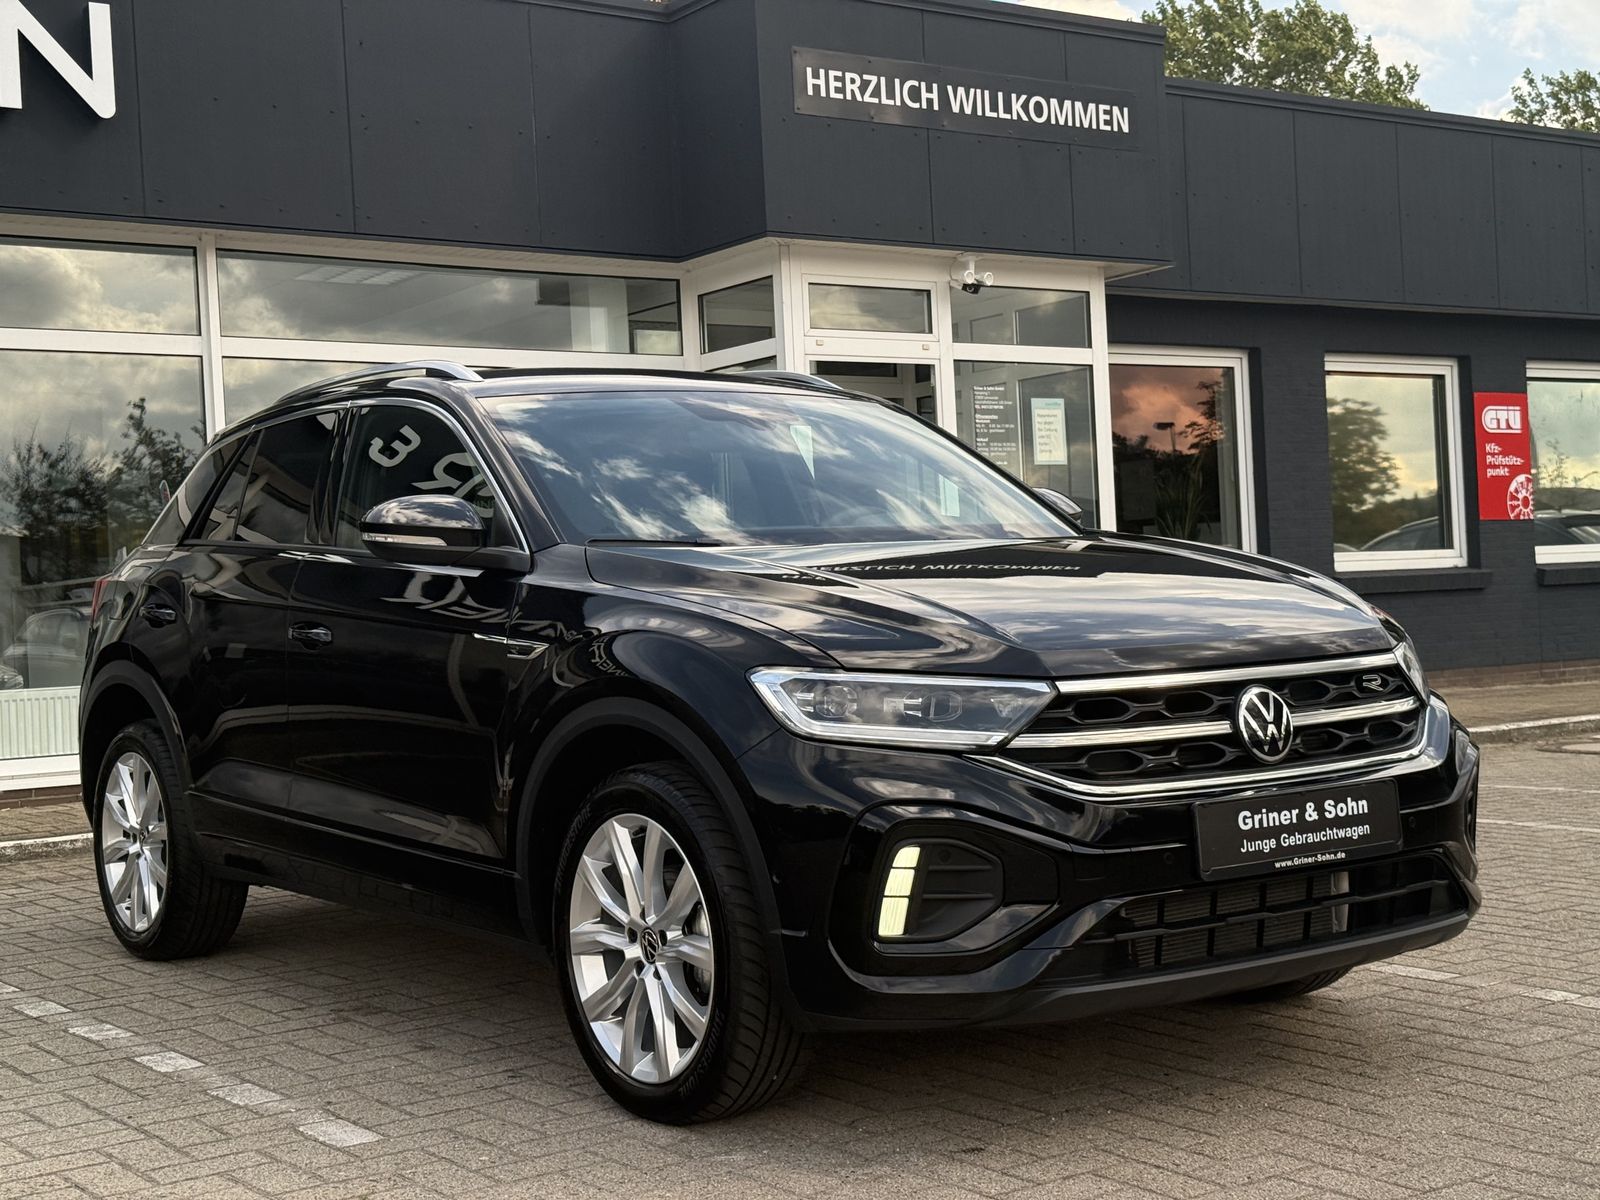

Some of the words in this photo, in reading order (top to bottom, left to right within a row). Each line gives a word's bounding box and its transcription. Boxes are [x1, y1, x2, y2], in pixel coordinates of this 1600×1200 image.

[806, 66, 939, 111] HERZLICH
[946, 84, 1130, 134] WILLKOMMEN
[1485, 442, 1502, 453] Kfz-
[1486, 454, 1525, 466] Prüfstütz-
[1486, 467, 1509, 478] punkt
[1237, 808, 1300, 831] Griner
[1304, 801, 1319, 822] &
[1323, 797, 1369, 819] Sohn
[1240, 838, 1277, 853] Junge
[1280, 824, 1371, 847] Gebrauchtwagen
[1274, 851, 1346, 869] www.Griner-Sohn.de
